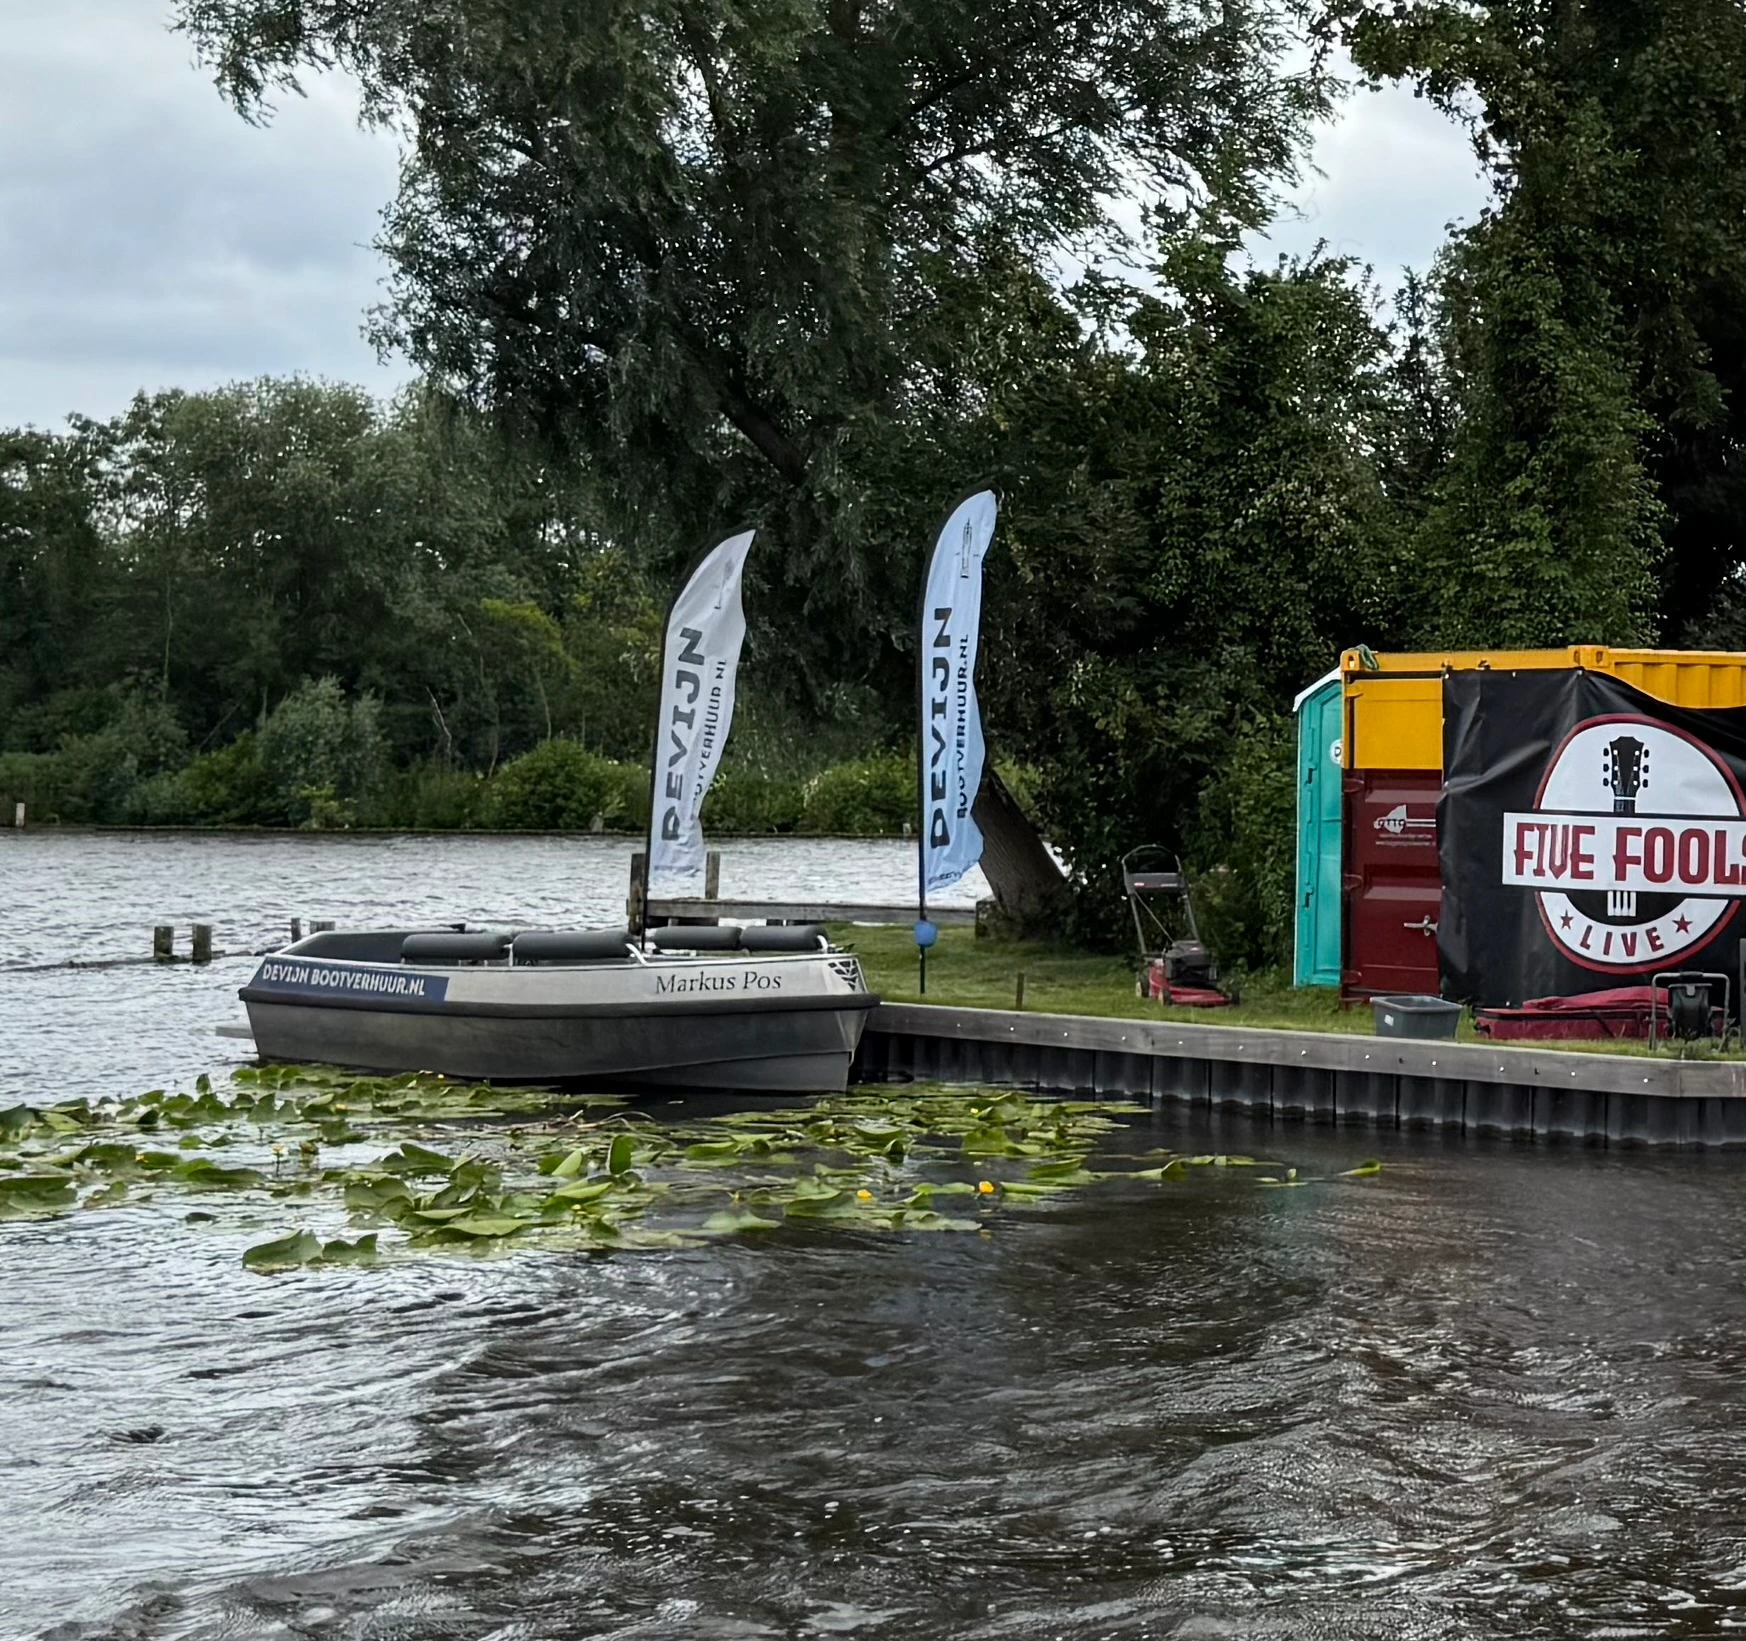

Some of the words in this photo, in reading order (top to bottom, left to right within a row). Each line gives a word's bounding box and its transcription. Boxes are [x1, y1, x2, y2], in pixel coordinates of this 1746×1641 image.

[662, 627, 705, 841] DEVIJN
[931, 607, 952, 849] DEVIJN
[1514, 822, 1596, 880] FIVE
[1579, 926, 1664, 957] LIVE
[263, 964, 308, 984] DEVIJN
[311, 969, 425, 996] BOOTVERHUUR.NL
[656, 971, 736, 994] Markus
[743, 971, 782, 990] Pos
